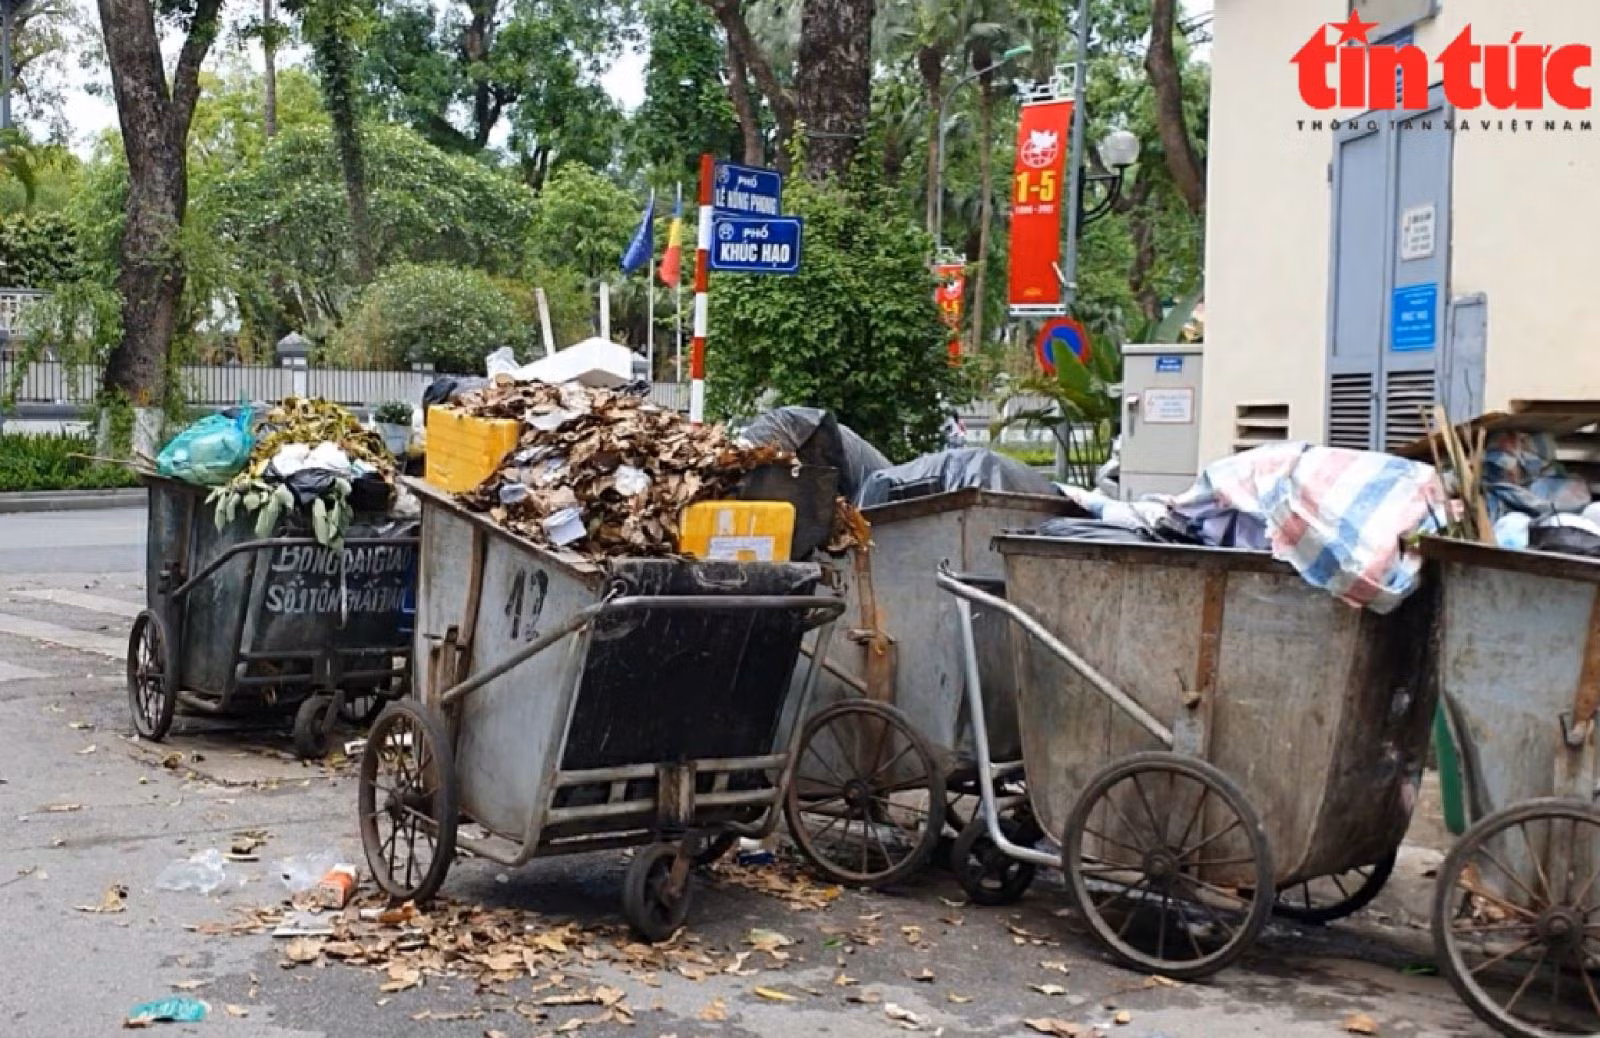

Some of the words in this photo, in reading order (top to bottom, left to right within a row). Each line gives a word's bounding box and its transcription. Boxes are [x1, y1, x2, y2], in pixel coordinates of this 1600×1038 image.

[1015, 170, 1057, 203] 1-5
[743, 224, 769, 239] PHỐ
[720, 240, 759, 262] KHÚC
[761, 243, 791, 268] HẠO
